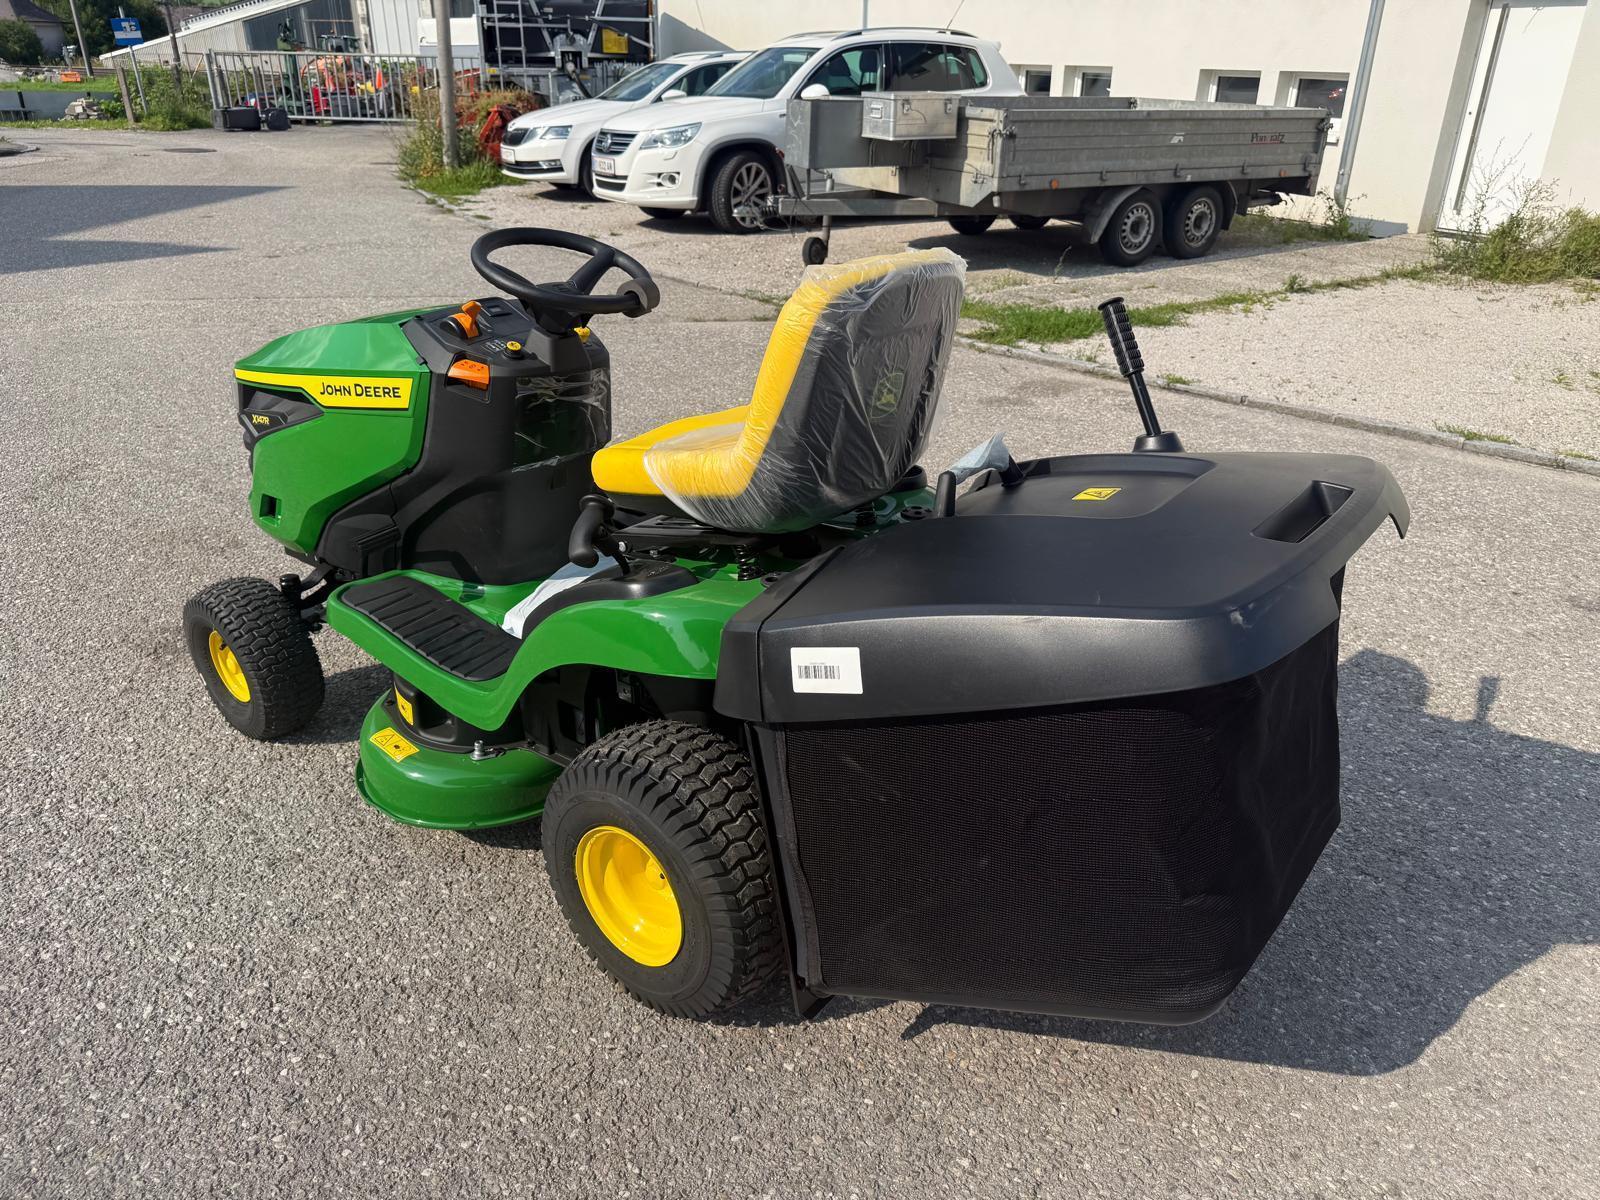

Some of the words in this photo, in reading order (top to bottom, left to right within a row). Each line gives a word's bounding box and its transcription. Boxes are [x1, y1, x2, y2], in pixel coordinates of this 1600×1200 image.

[319, 382, 352, 397] JOHN
[353, 383, 402, 399] DEERE
[251, 414, 270, 425] X147R
